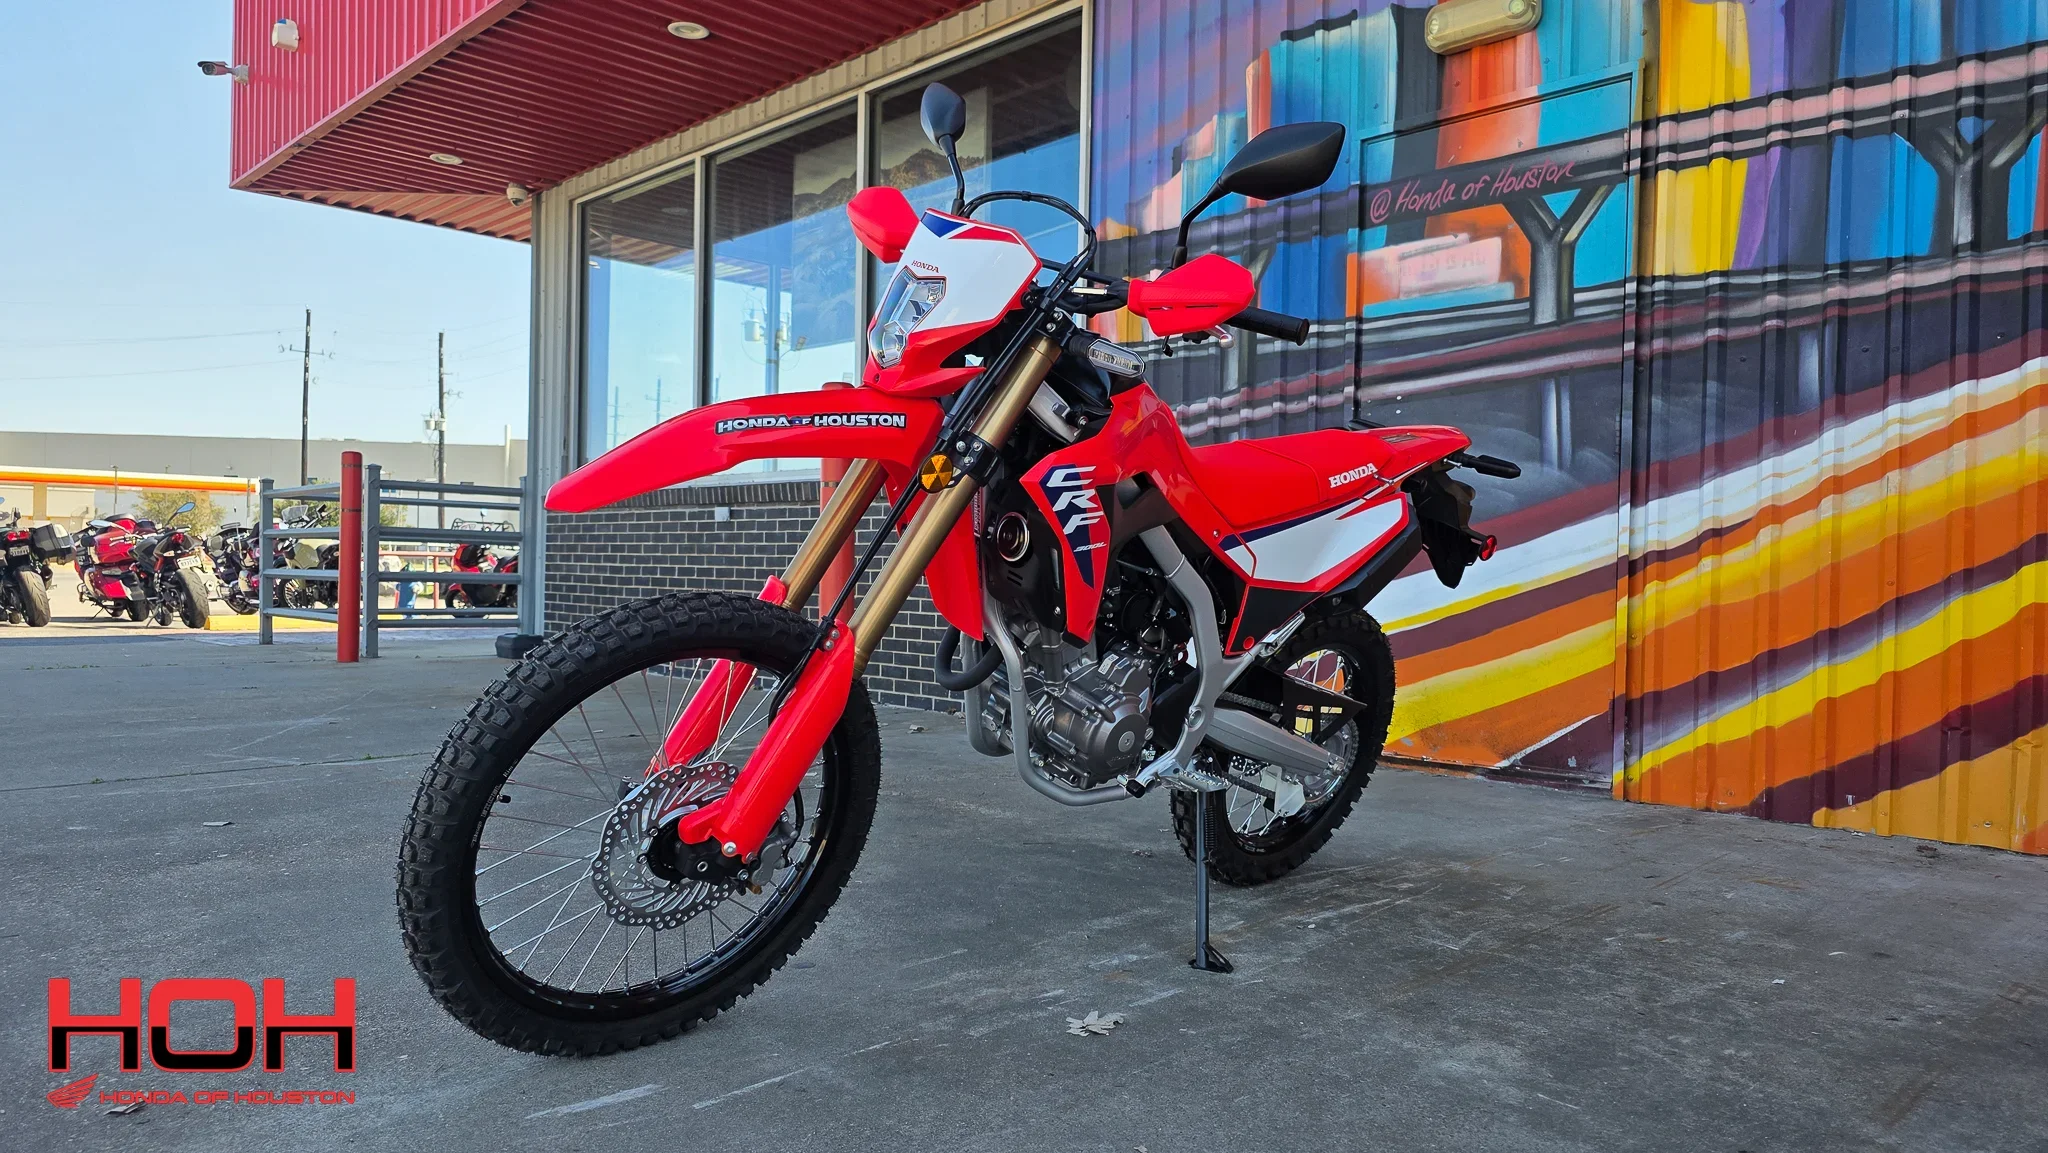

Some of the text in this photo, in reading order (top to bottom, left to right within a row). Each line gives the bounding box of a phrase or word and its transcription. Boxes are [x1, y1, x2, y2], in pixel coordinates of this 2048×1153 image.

[1369, 157, 1576, 224] @ Honda of Houston
[911, 260, 939, 273] HONDA
[717, 416, 791, 434] HONDA
[814, 414, 906, 428] HOUSTON
[1328, 462, 1378, 489] HONDA
[1046, 465, 1104, 535] CRF
